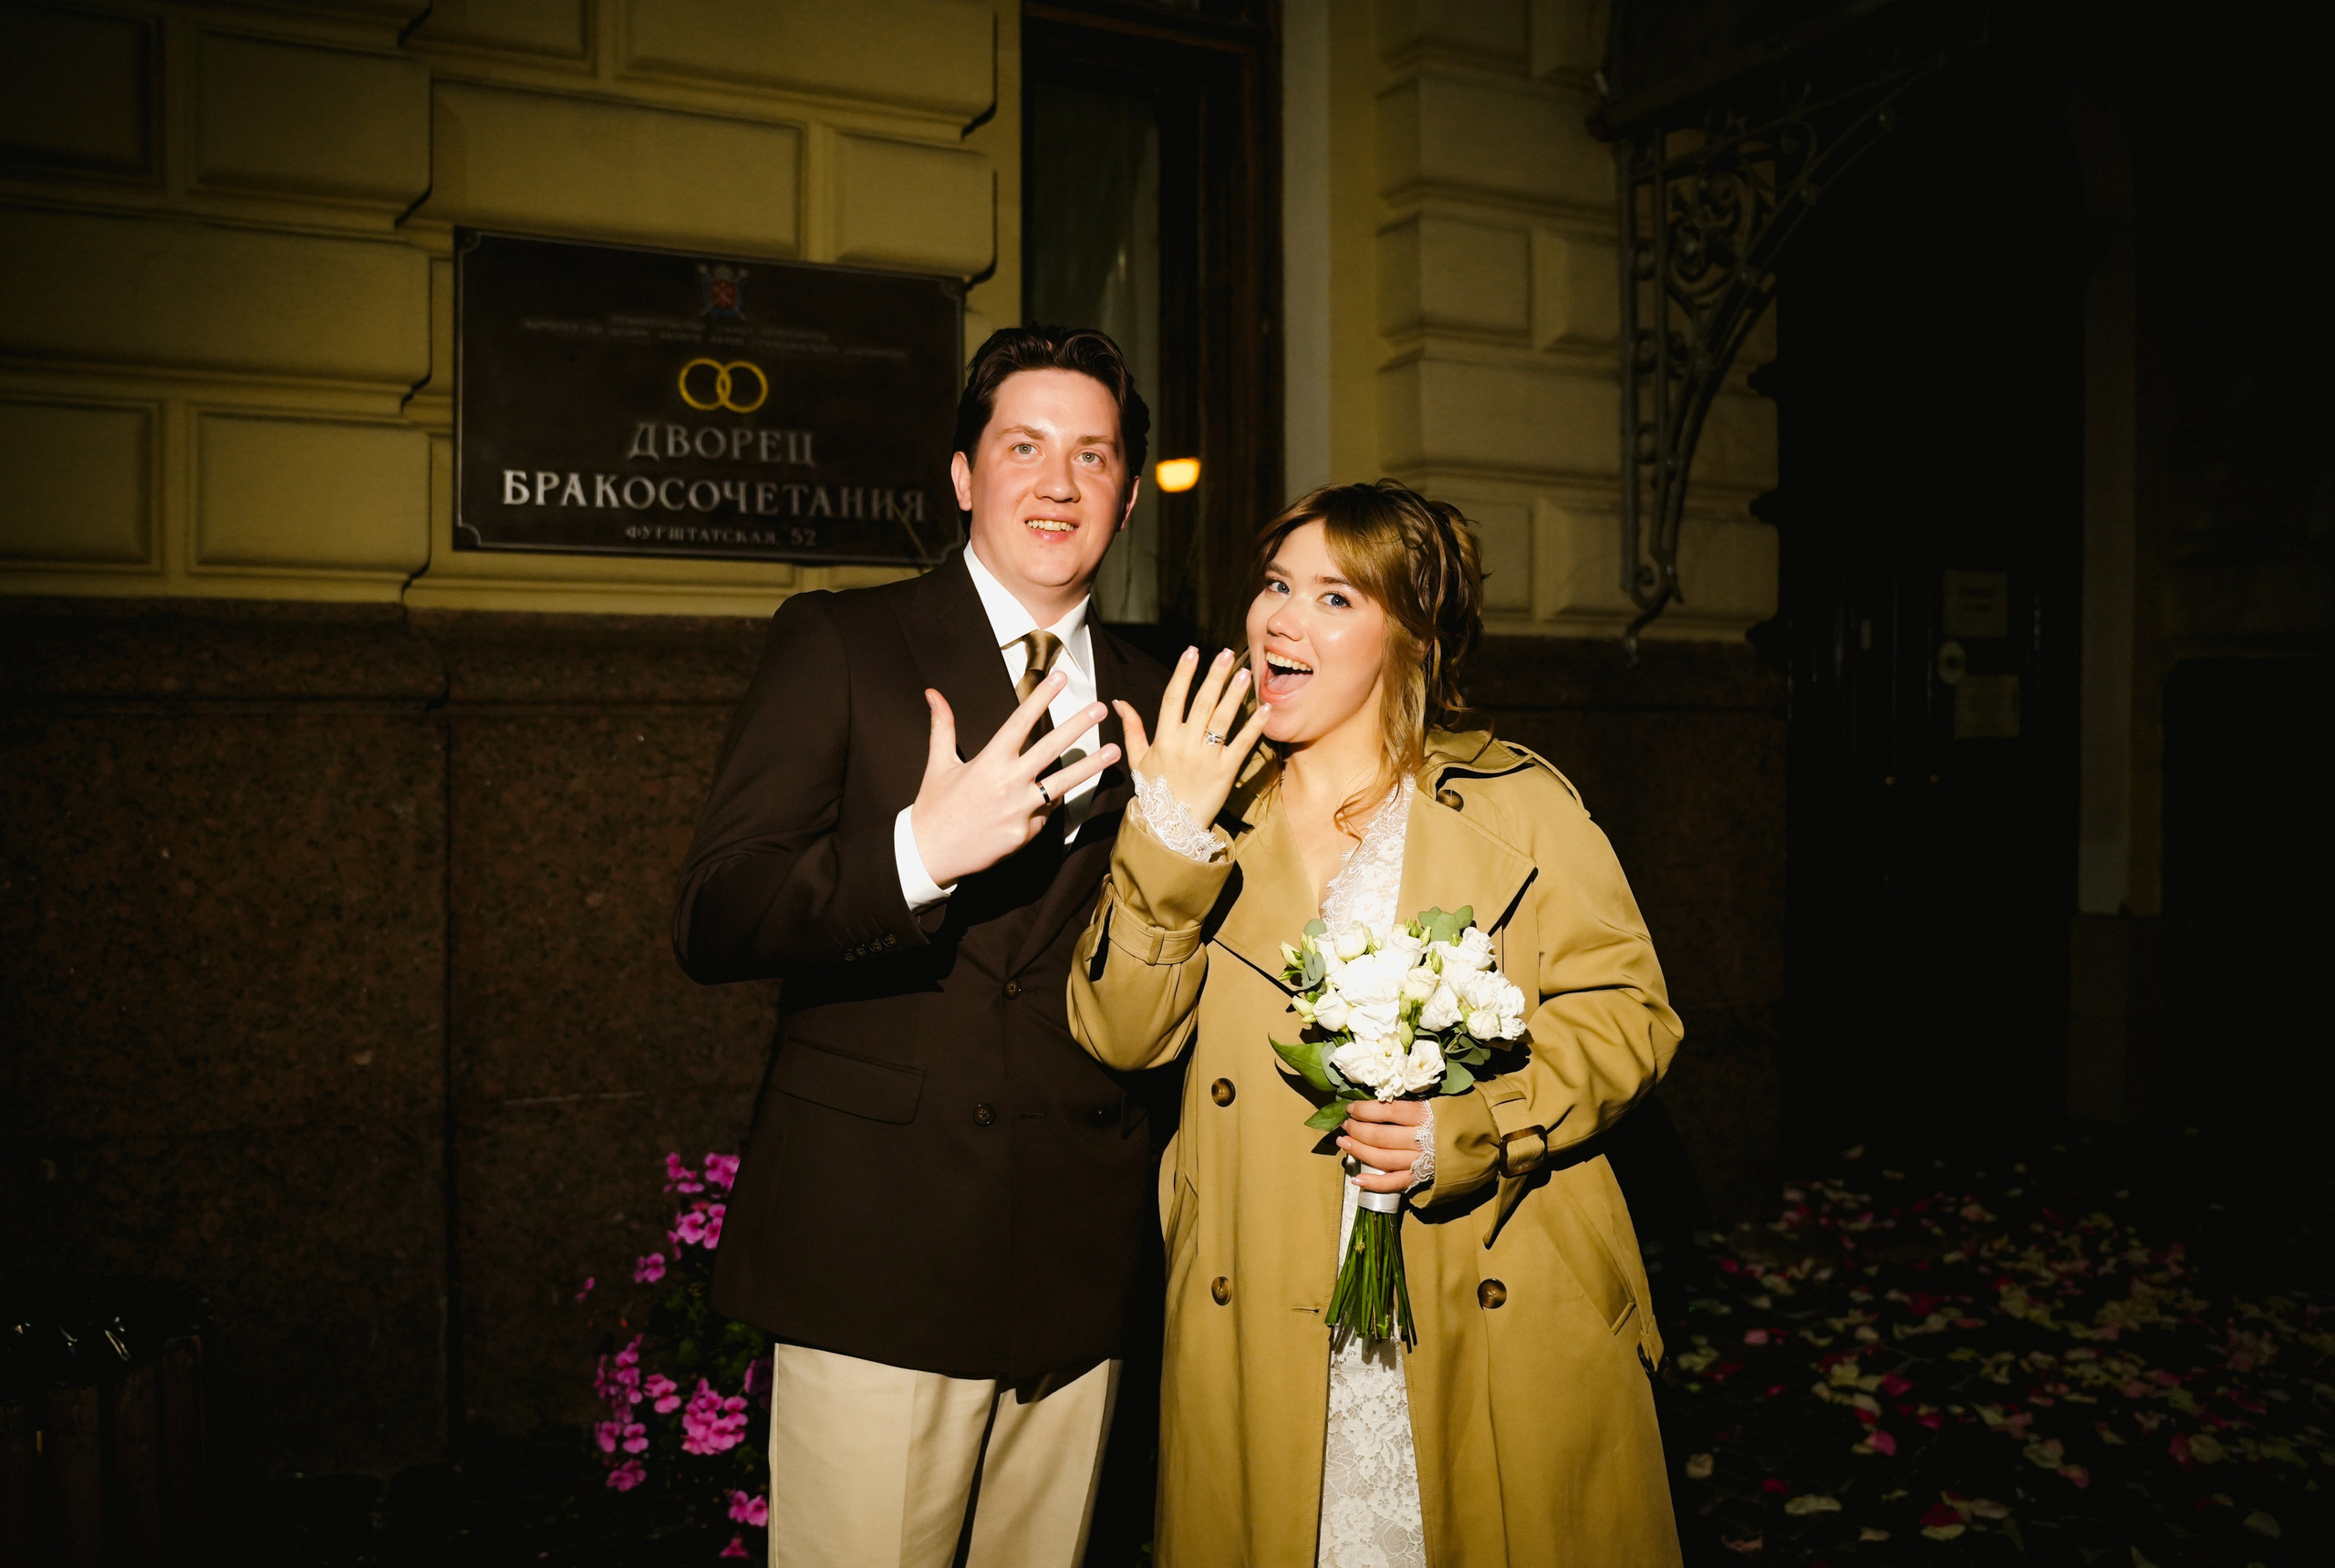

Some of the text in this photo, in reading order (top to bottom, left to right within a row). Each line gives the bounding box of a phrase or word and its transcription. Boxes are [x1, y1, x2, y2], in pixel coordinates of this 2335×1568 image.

[628, 421, 815, 468] ДВОРЕЦ
[501, 468, 926, 524] БРАКОСОЧЕТАНИЯ
[789, 527, 818, 546] 52
